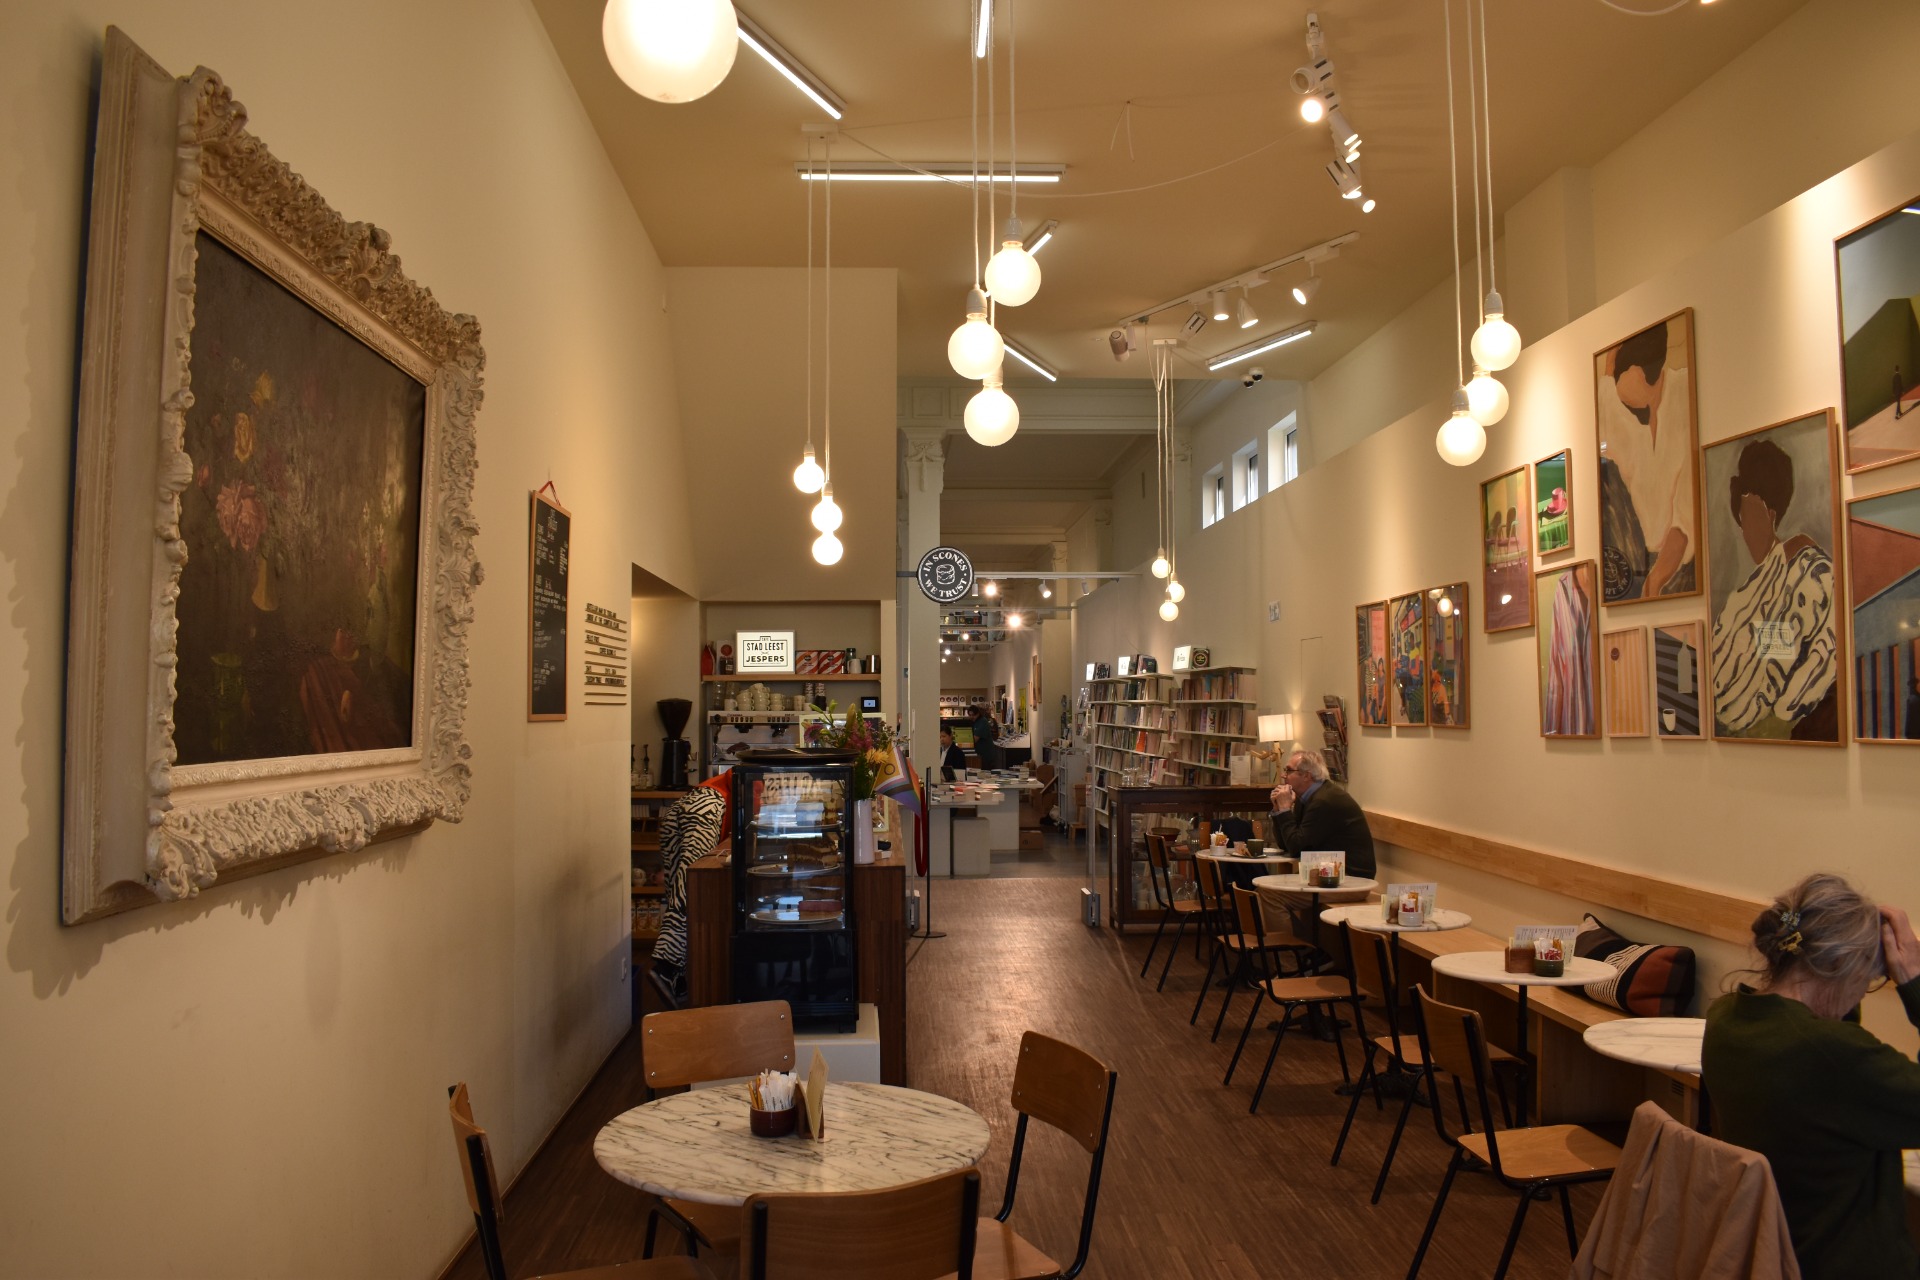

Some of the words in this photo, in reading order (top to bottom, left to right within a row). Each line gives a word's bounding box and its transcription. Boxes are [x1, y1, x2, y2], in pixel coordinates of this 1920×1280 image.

[923, 560, 934, 572] IN
[932, 552, 968, 571] SCONES
[925, 579, 938, 594] WE
[939, 578, 967, 597] TRUST
[746, 643, 763, 651] STAD
[765, 643, 784, 651] LEEST
